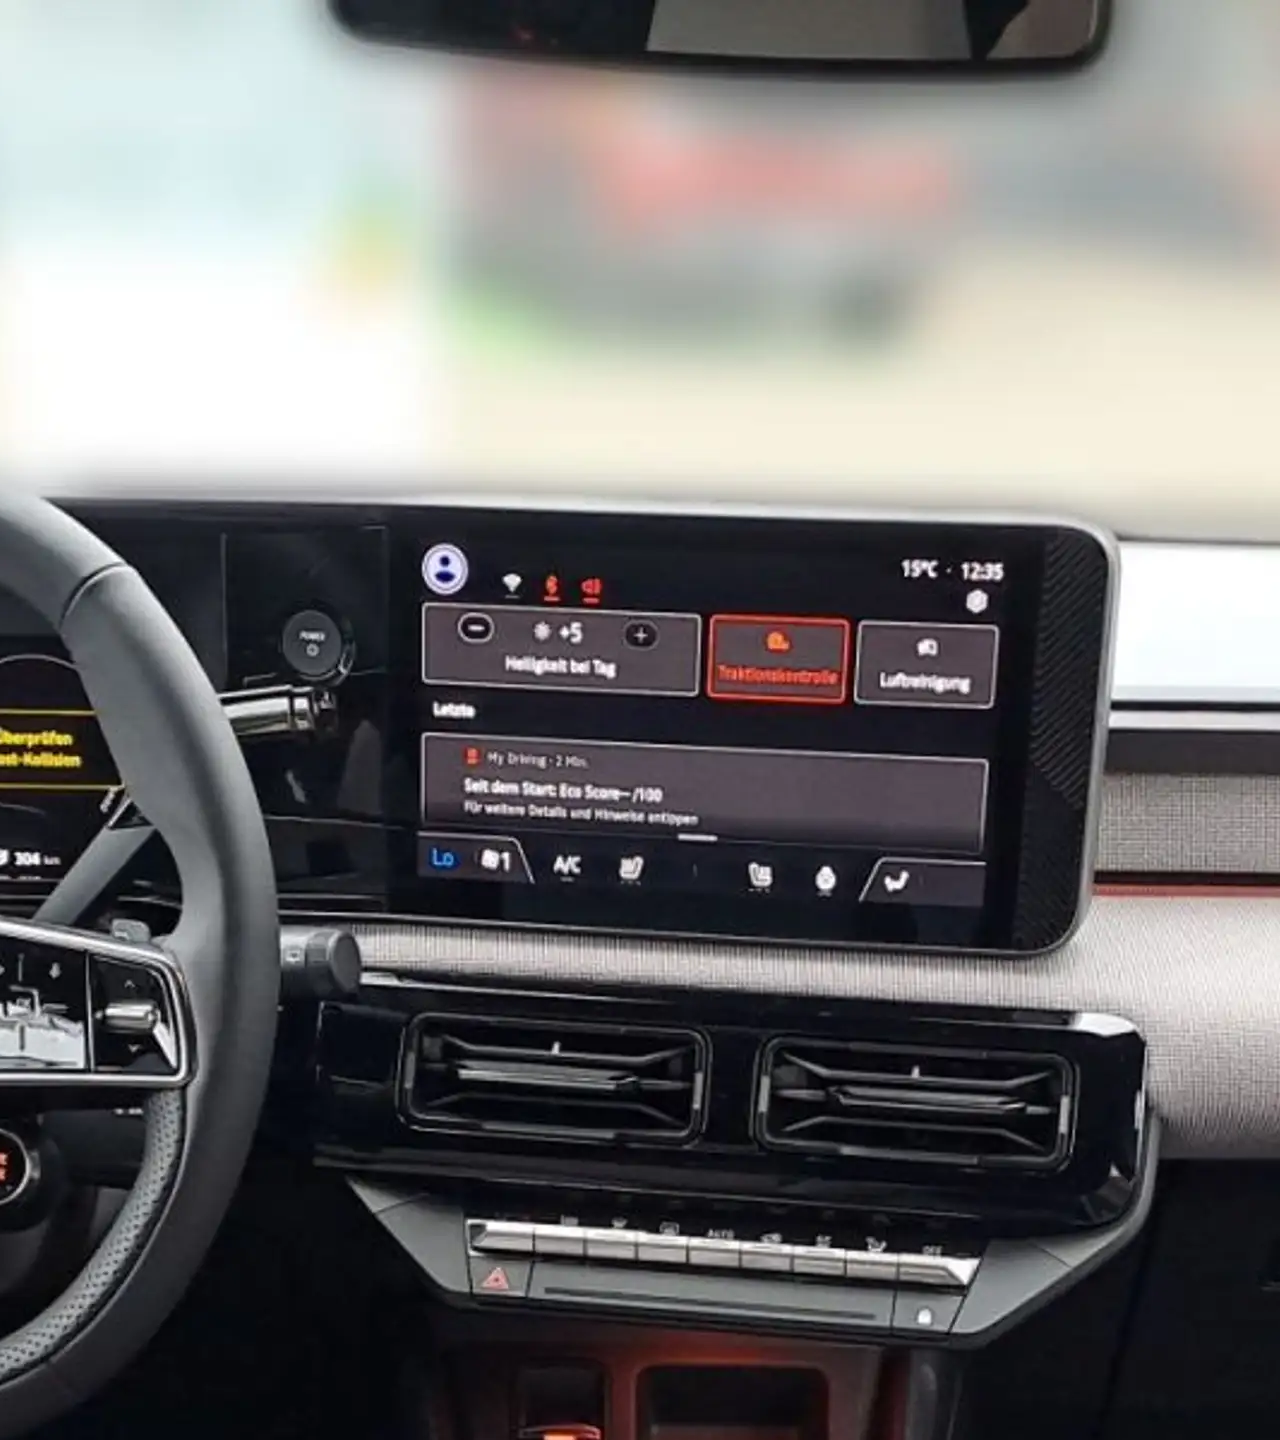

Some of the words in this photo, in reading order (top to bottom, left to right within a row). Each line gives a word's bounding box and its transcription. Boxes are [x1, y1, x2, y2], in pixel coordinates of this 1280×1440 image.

[961, 562, 1004, 581] 12:35
[505, 655, 568, 676] Helligkeit
[570, 660, 591, 675] bei
[592, 660, 617, 679] Tag
[880, 672, 971, 694] Luftreinigung
[487, 752, 504, 766] My
[508, 753, 547, 769] Driving
[464, 777, 490, 793] Seit
[491, 778, 519, 795] dem
[559, 782, 582, 799] Eco
[528, 804, 567, 819] Details
[570, 807, 592, 820] und
[432, 848, 454, 867] Lo
[553, 855, 582, 875] A/C
